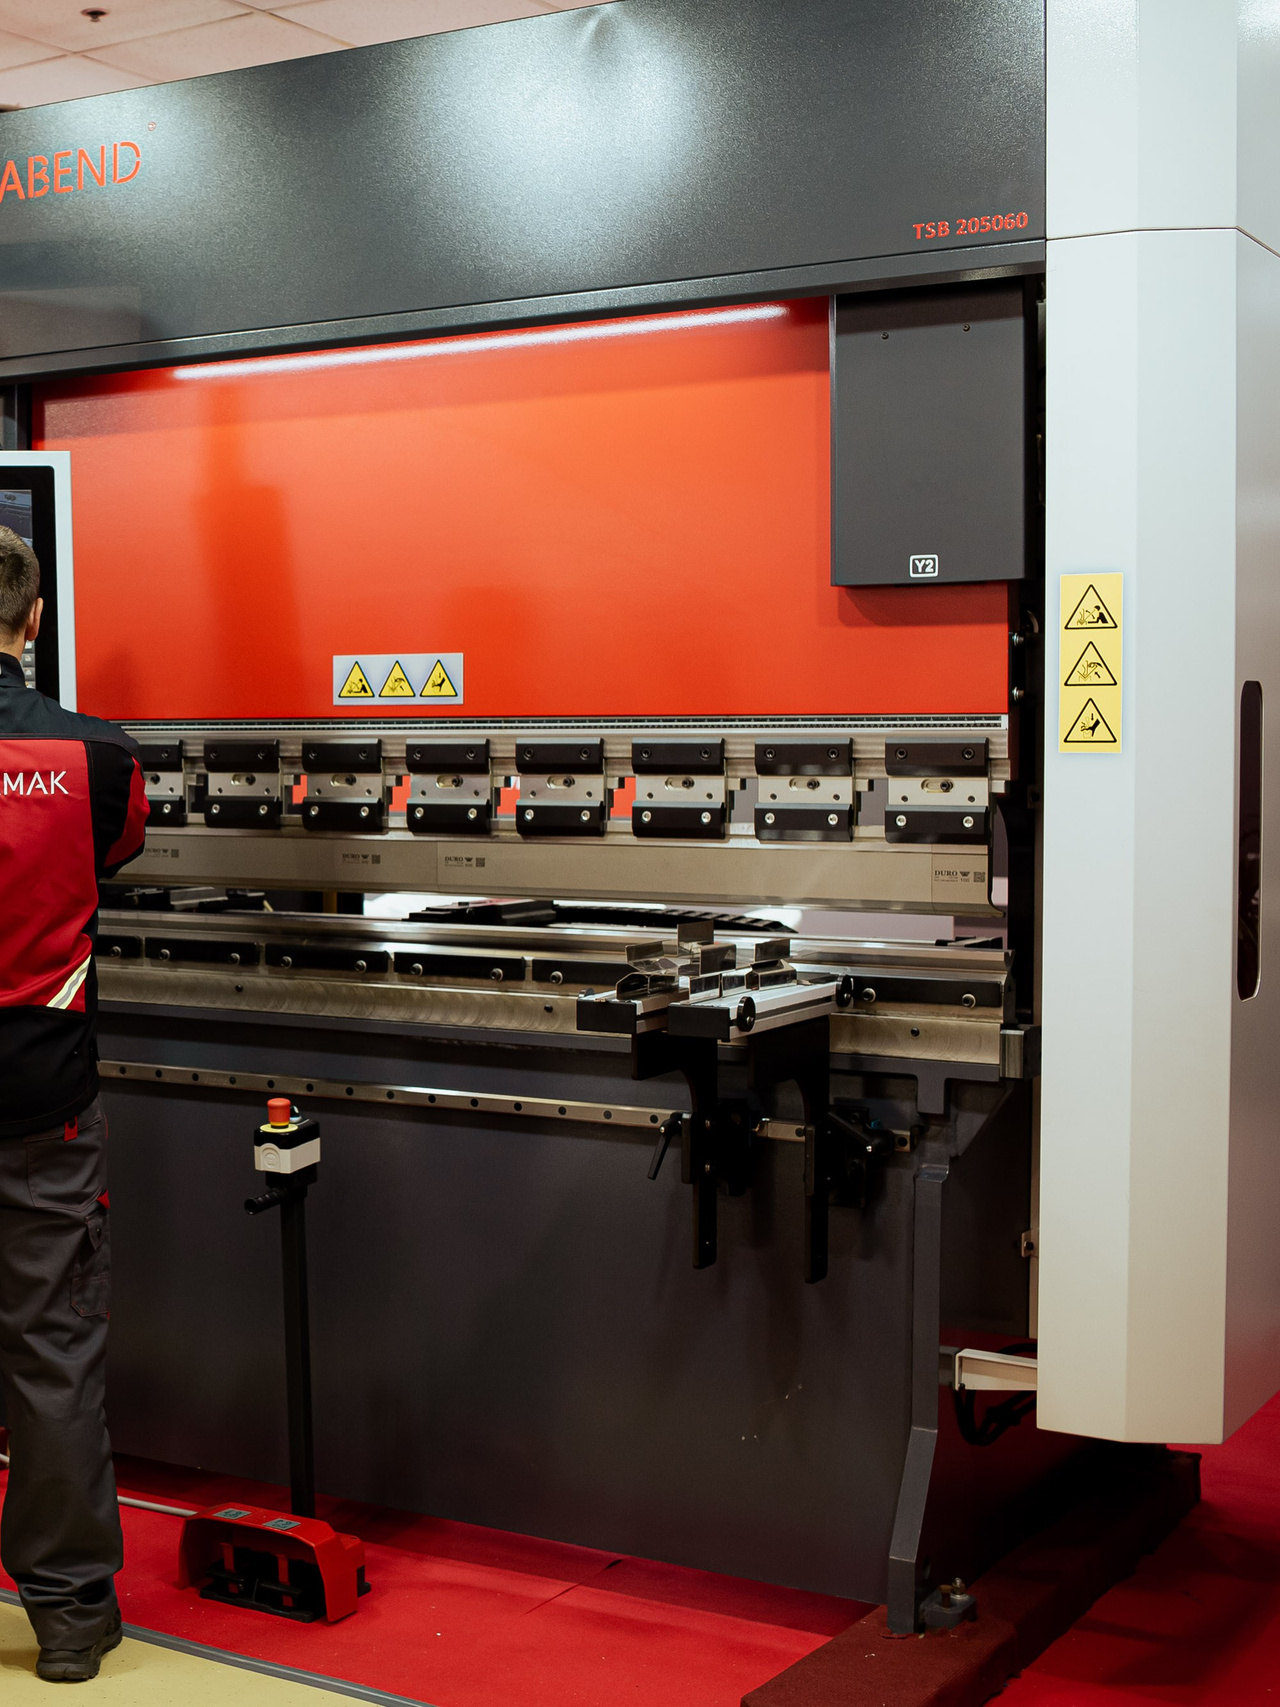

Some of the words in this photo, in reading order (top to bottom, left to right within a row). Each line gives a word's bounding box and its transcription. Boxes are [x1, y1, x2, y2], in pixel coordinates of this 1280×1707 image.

[912, 220, 951, 240] TSB
[955, 210, 1029, 236] 205060
[914, 559, 934, 573] Y2
